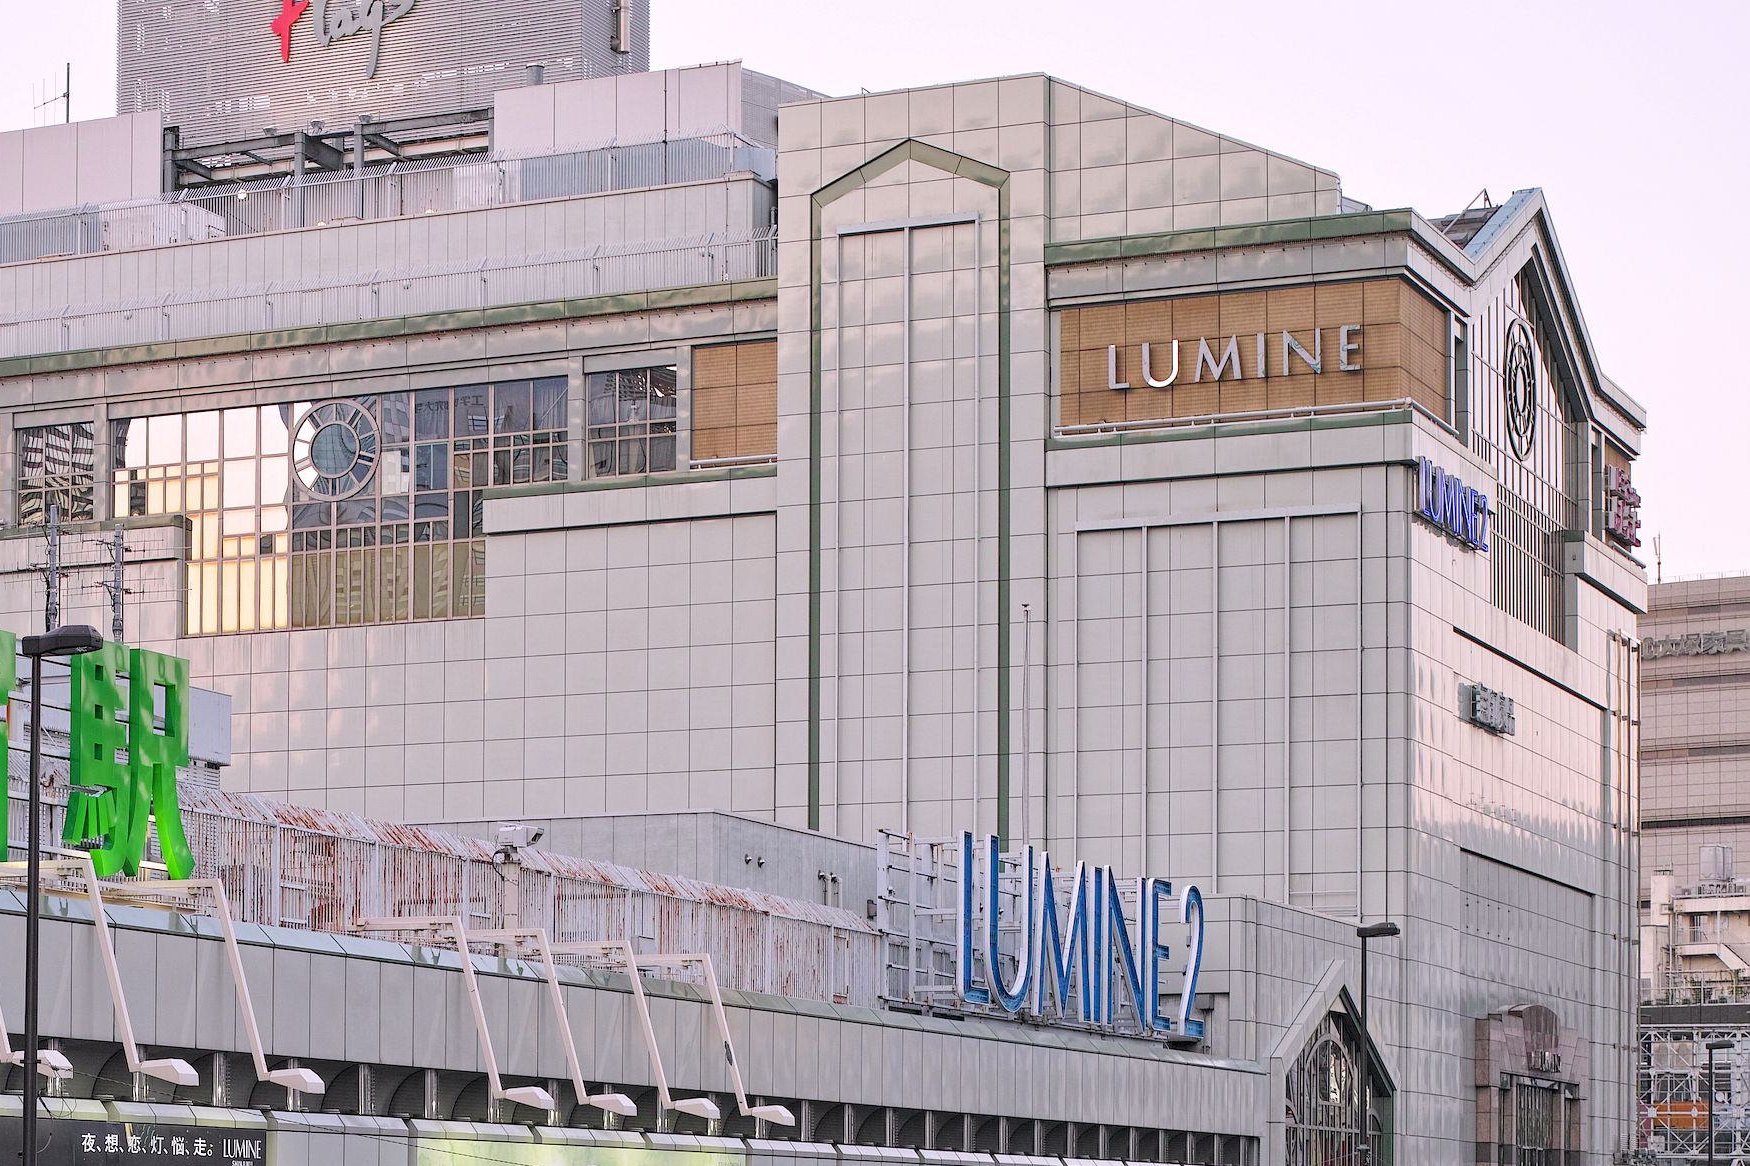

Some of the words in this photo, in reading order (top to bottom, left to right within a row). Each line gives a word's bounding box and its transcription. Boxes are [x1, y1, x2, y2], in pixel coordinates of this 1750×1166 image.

[1108, 323, 1361, 390] LUMINE
[1415, 456, 1478, 546] LUMINE
[1479, 495, 1489, 552] 2
[957, 830, 1171, 1034] LUMINE
[1178, 884, 1205, 1040] 2
[81, 1132, 214, 1157] 夜、想、恋、灯、悩、走。
[223, 1138, 262, 1160] LUMINE
